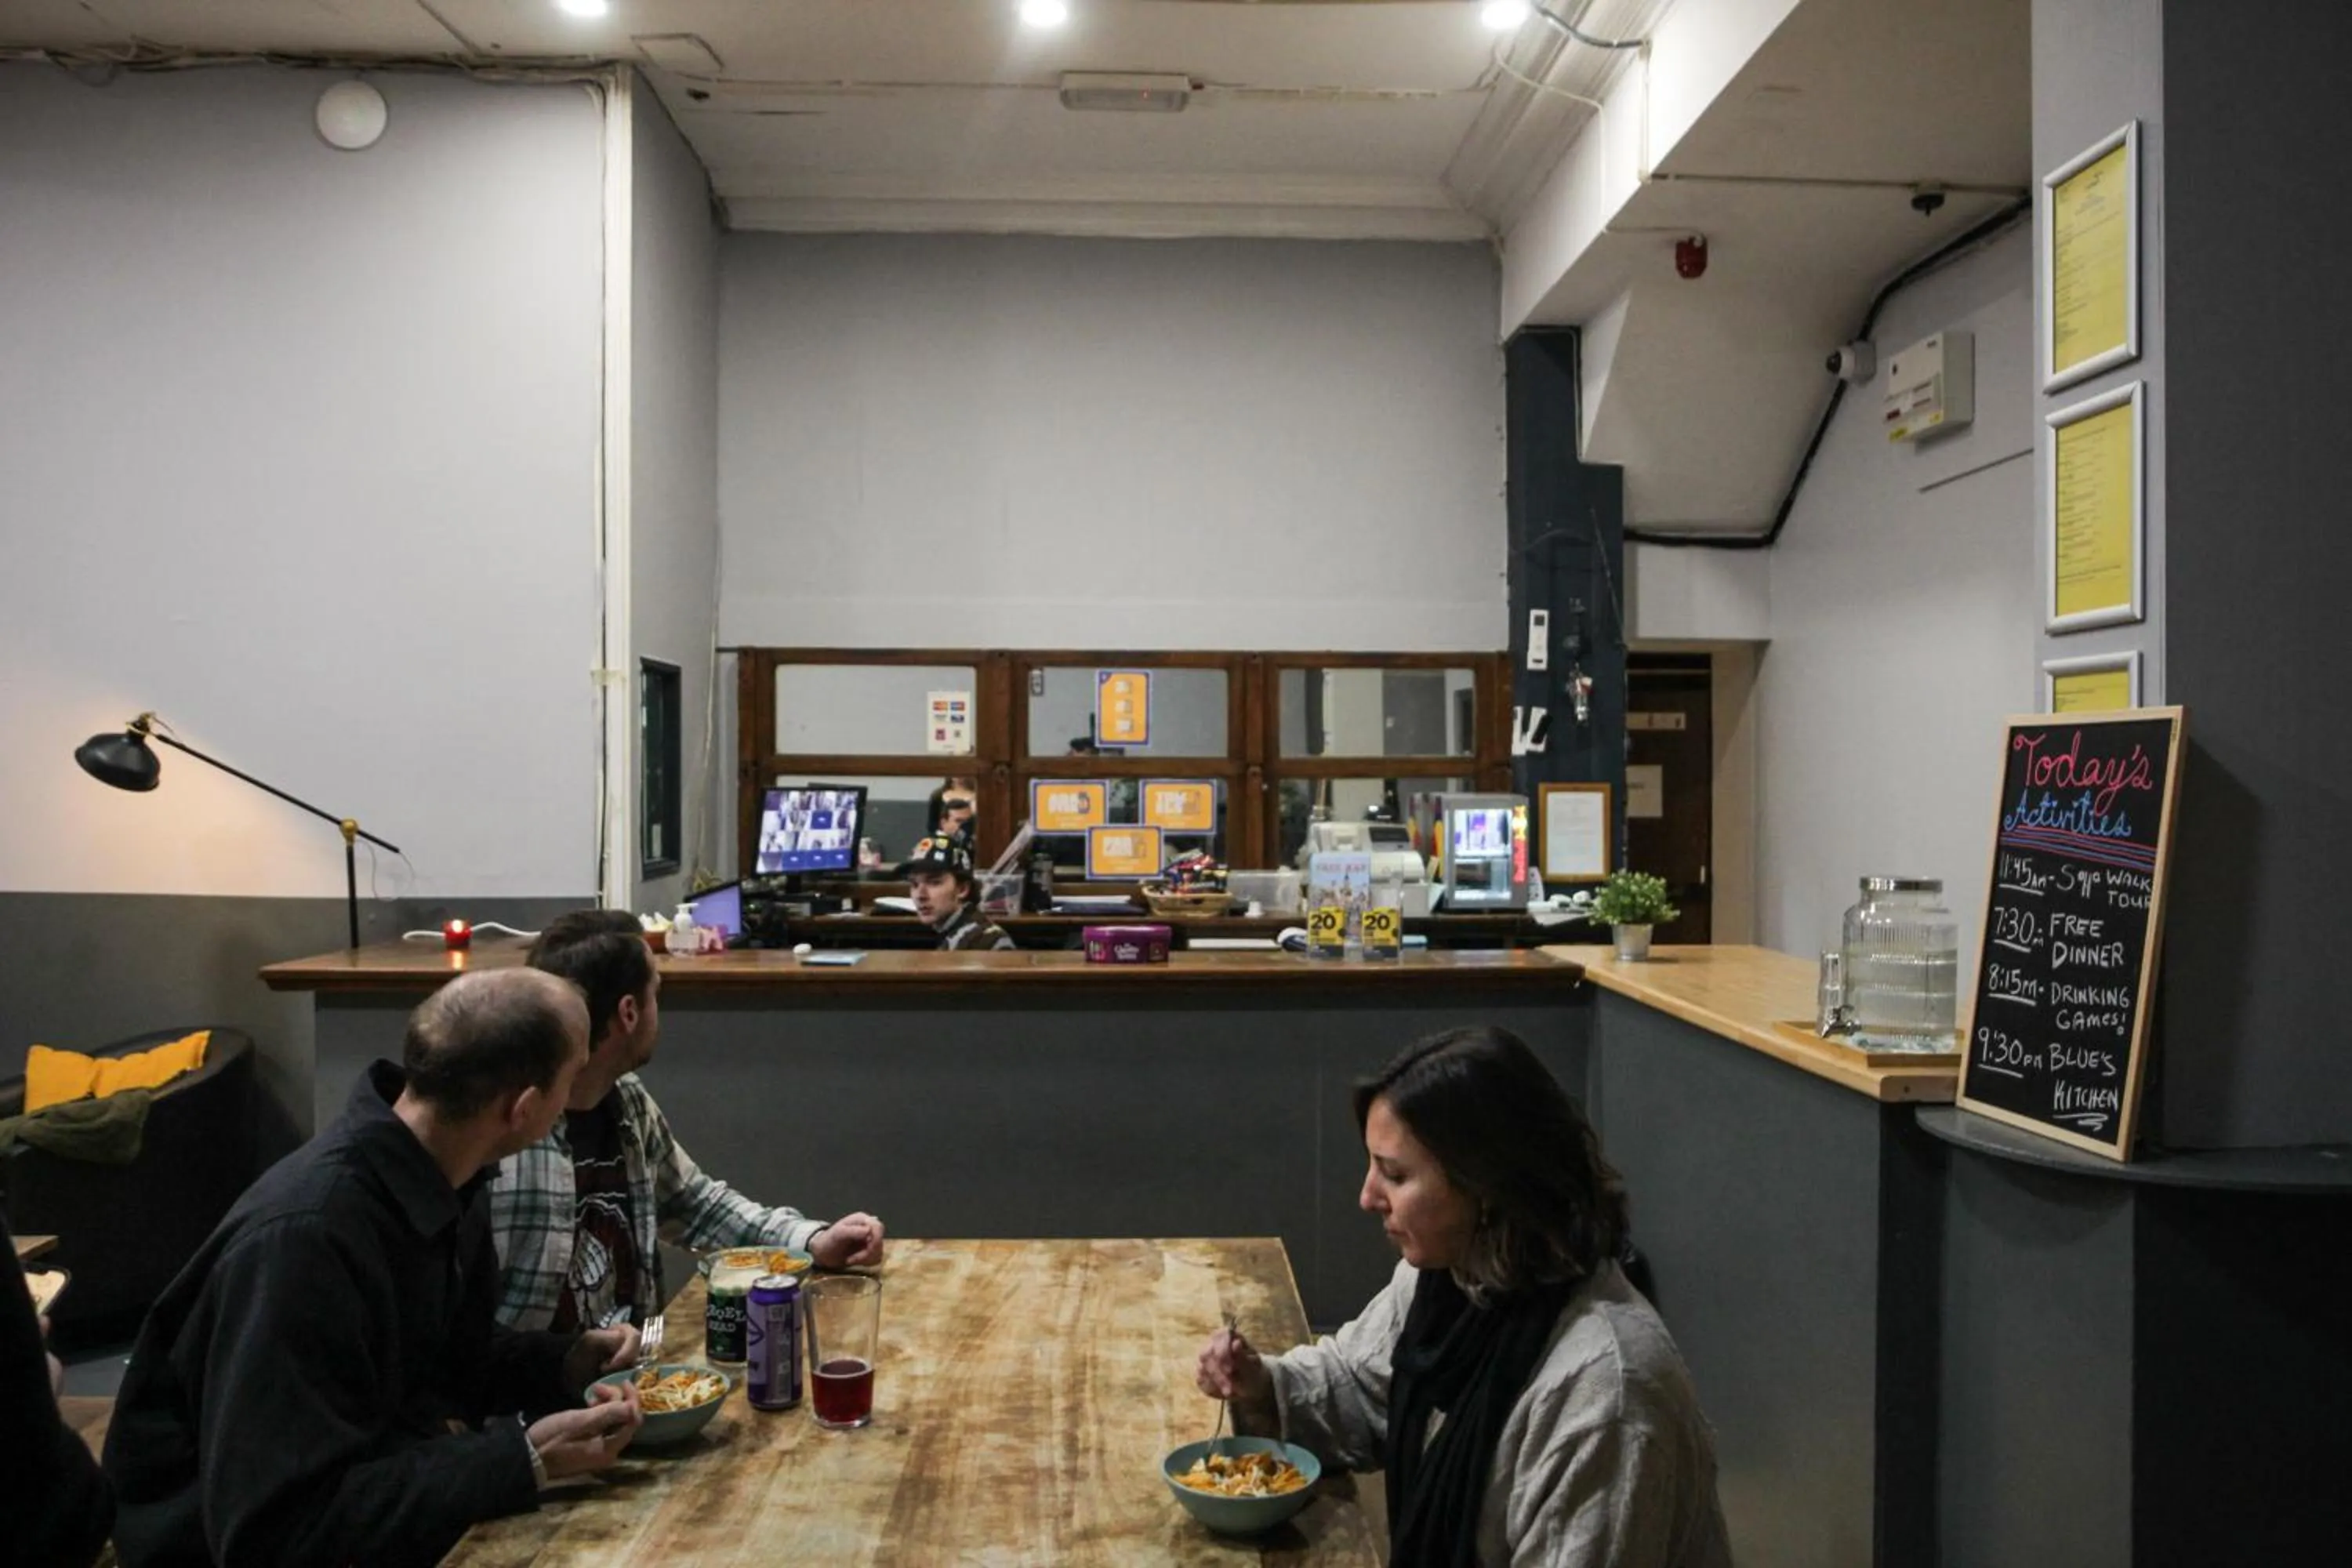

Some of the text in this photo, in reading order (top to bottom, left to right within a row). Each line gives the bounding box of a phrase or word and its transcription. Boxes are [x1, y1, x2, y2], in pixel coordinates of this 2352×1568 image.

[2013, 731, 2153, 817] Today's
[2003, 789, 2132, 837] Activities
[1310, 913, 1337, 931] 20
[1364, 913, 1390, 931] 20
[2050, 913, 2104, 938] FREE
[2052, 941, 2125, 969] DINNER
[2051, 982, 2130, 1008] DRINKING
[2053, 1078, 2118, 1111] KITCHEN
